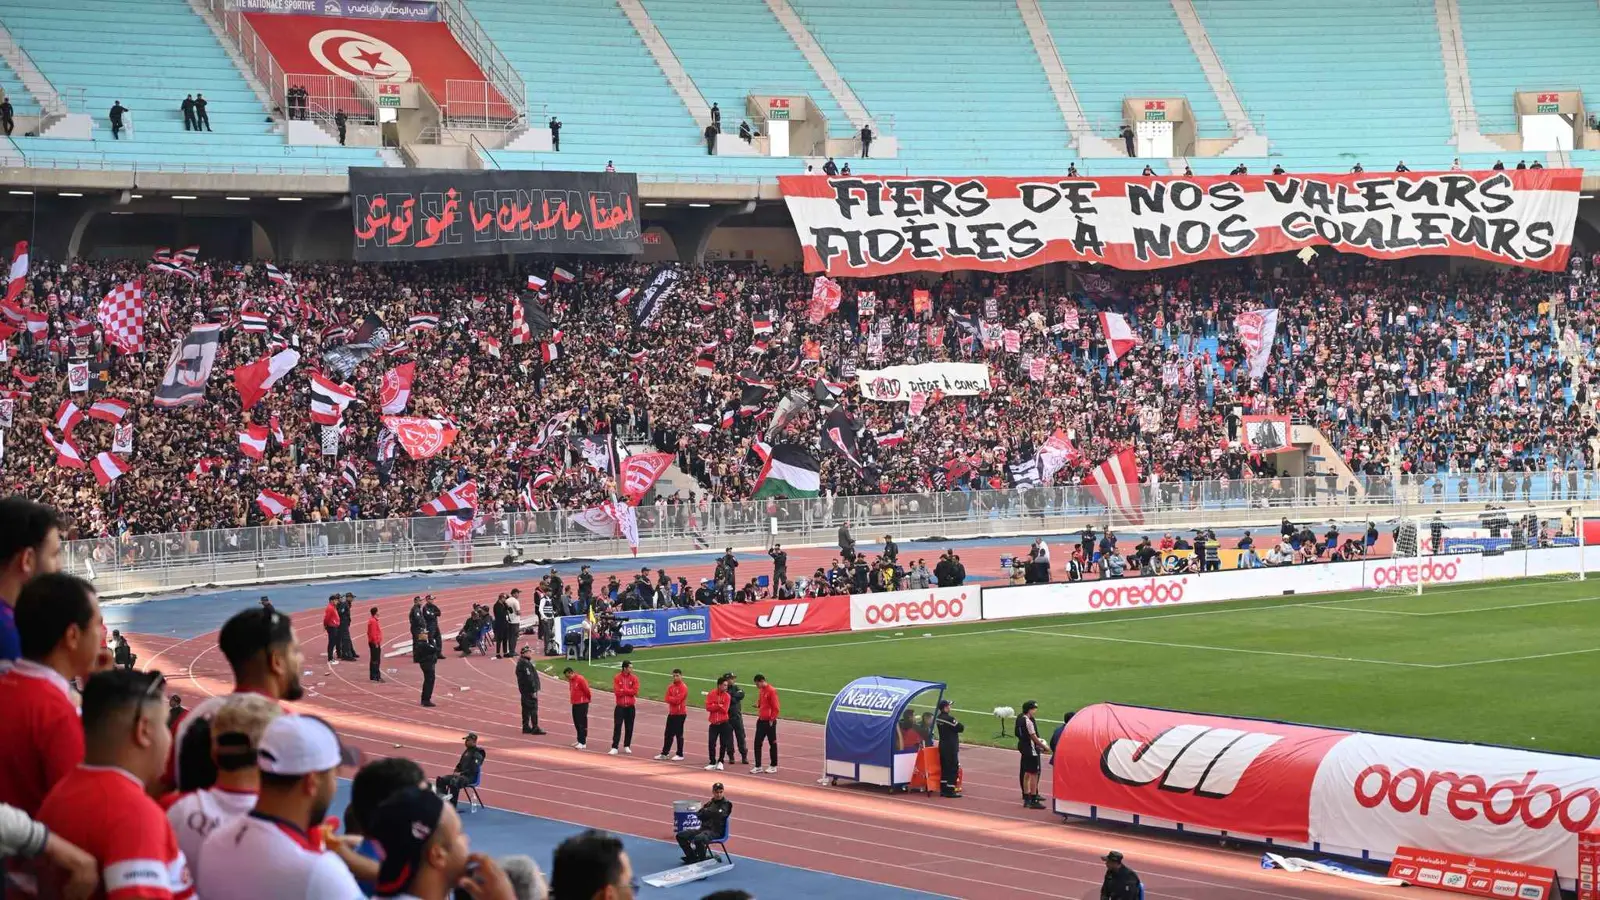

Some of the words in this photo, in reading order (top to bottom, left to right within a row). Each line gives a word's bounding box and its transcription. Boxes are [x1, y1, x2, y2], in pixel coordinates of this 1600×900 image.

[285, 1, 316, 10] SPORTIVE
[831, 179, 990, 219] FIERS
[1021, 181, 1099, 214] DE
[1128, 181, 1244, 215] NOS
[1265, 174, 1515, 214] VALEURS
[810, 219, 1044, 268] FIDÈLES
[1073, 215, 1103, 256] À
[1133, 214, 1257, 260] NOS
[1281, 212, 1554, 260] COULEURS
[1374, 557, 1457, 585] ooredoo
[1089, 578, 1183, 609] ooredoo
[865, 594, 963, 624] ooredoo
[620, 624, 654, 636] Natilait
[670, 620, 703, 632] Natilait
[841, 687, 899, 710] Natilait
[1355, 763, 1600, 832] ooredoo
